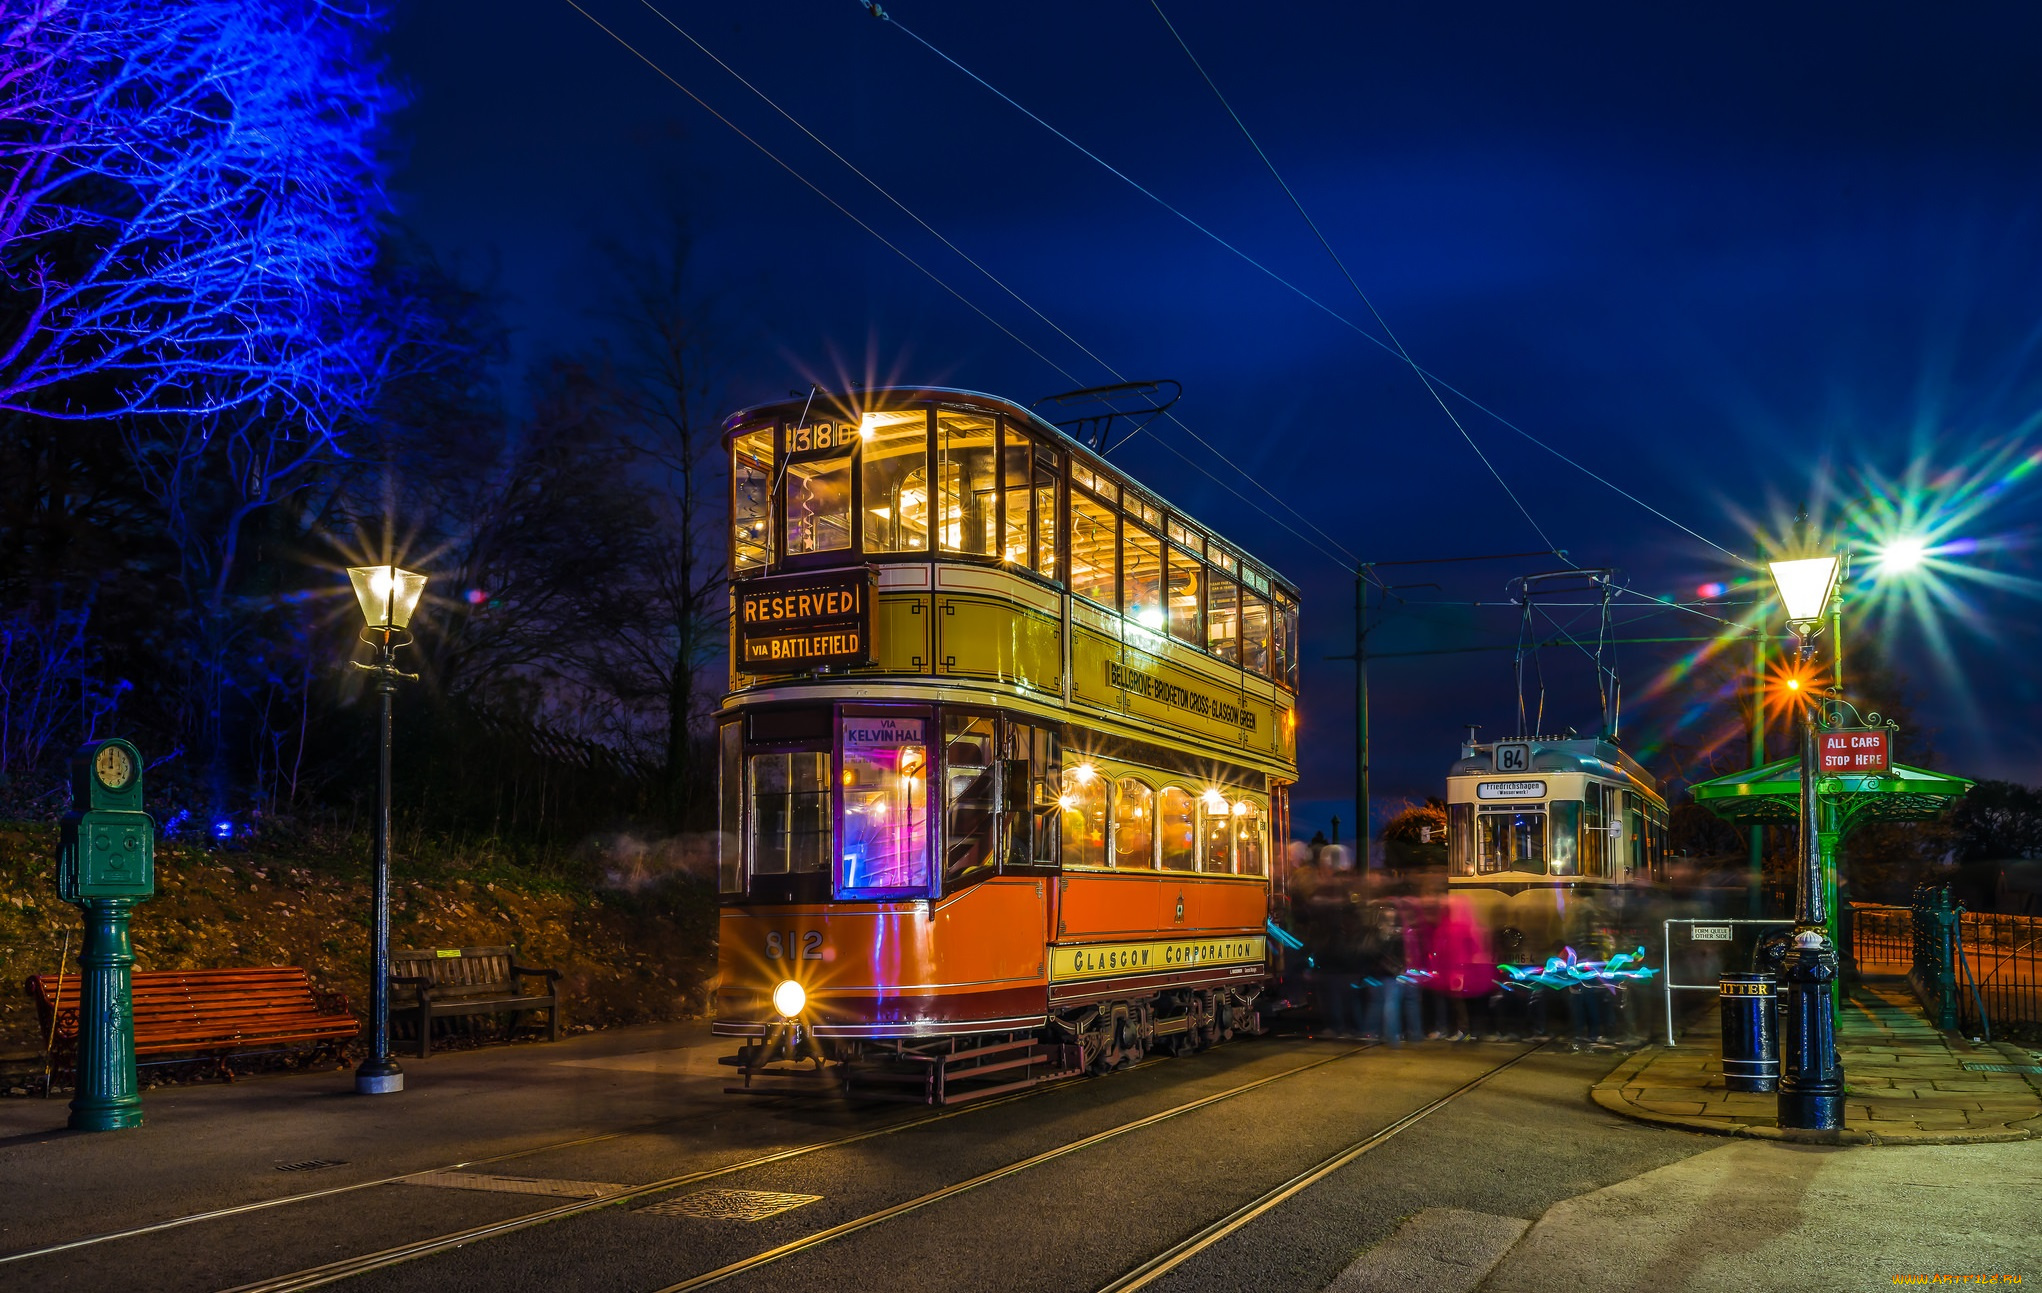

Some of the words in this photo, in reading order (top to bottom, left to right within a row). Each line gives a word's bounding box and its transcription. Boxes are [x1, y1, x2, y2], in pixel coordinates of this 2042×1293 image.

[745, 591, 853, 622] RESERVED
[752, 644, 768, 656] VIA
[771, 634, 859, 659] BATTLEFIELD
[880, 720, 896, 728] VIA
[1239, 709, 1256, 729] GREEN
[848, 729, 894, 742] KELVIN
[1827, 737, 1847, 749] ALL
[1851, 737, 1880, 748] CARS
[1503, 749, 1523, 769] 84
[1825, 755, 1850, 766] STOP
[1855, 754, 1882, 766] HERE
[1486, 782, 1540, 790] Friedrichshagen
[765, 930, 824, 960] 812
[1074, 949, 1149, 972] GLASGOW
[1165, 943, 1251, 964] CORPORATION
